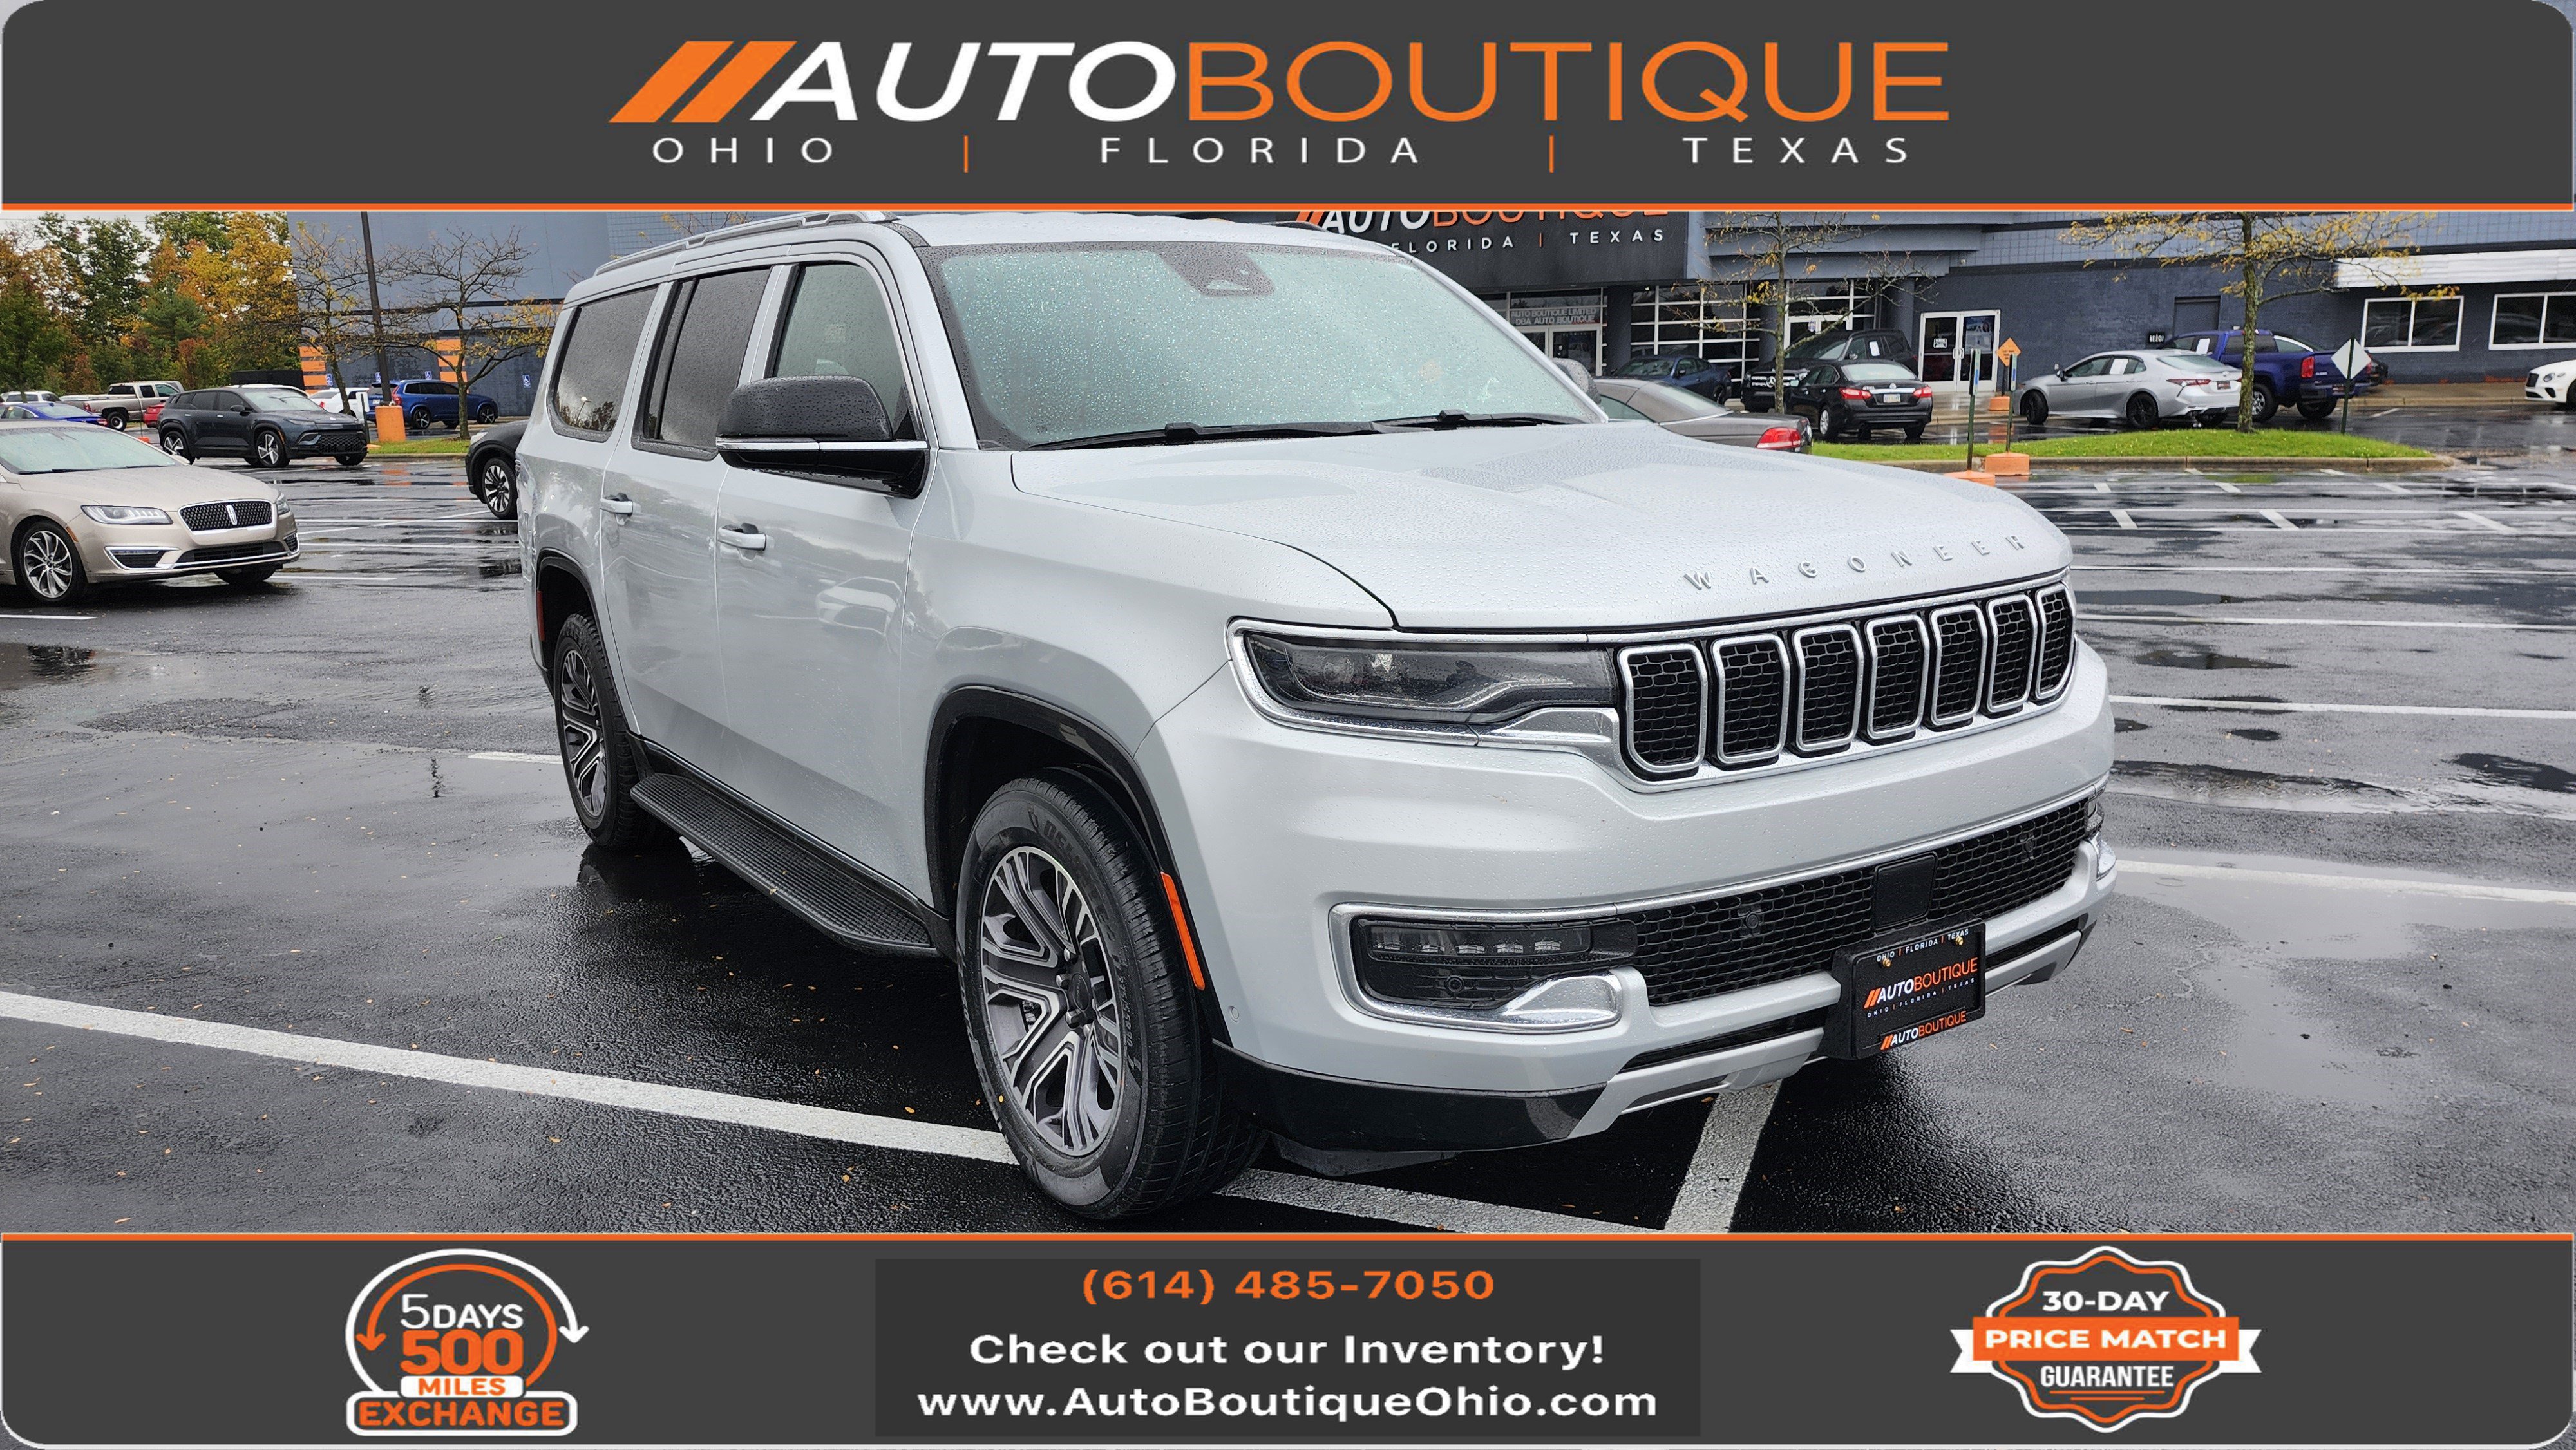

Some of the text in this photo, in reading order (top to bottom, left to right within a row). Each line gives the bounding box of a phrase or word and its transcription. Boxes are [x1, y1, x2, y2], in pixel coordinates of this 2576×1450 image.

[1392, 229, 1663, 254] FLORIDA TEXAS
[1532, 308, 1567, 317] BOUTIQUE
[1534, 316, 1555, 325] AUTO
[1557, 315, 1595, 323] BOUTIQUE
[1684, 534, 2024, 590] WAGONEER
[1877, 928, 1969, 963] OHIO FLORIDA TEXAS
[1867, 977, 1975, 1018] OHIO FLORIDA TEXAS
[1877, 957, 1978, 1004] AUTOBOUTIQUE
[1889, 1010, 1967, 1047] AUTOBOUTIQUE
